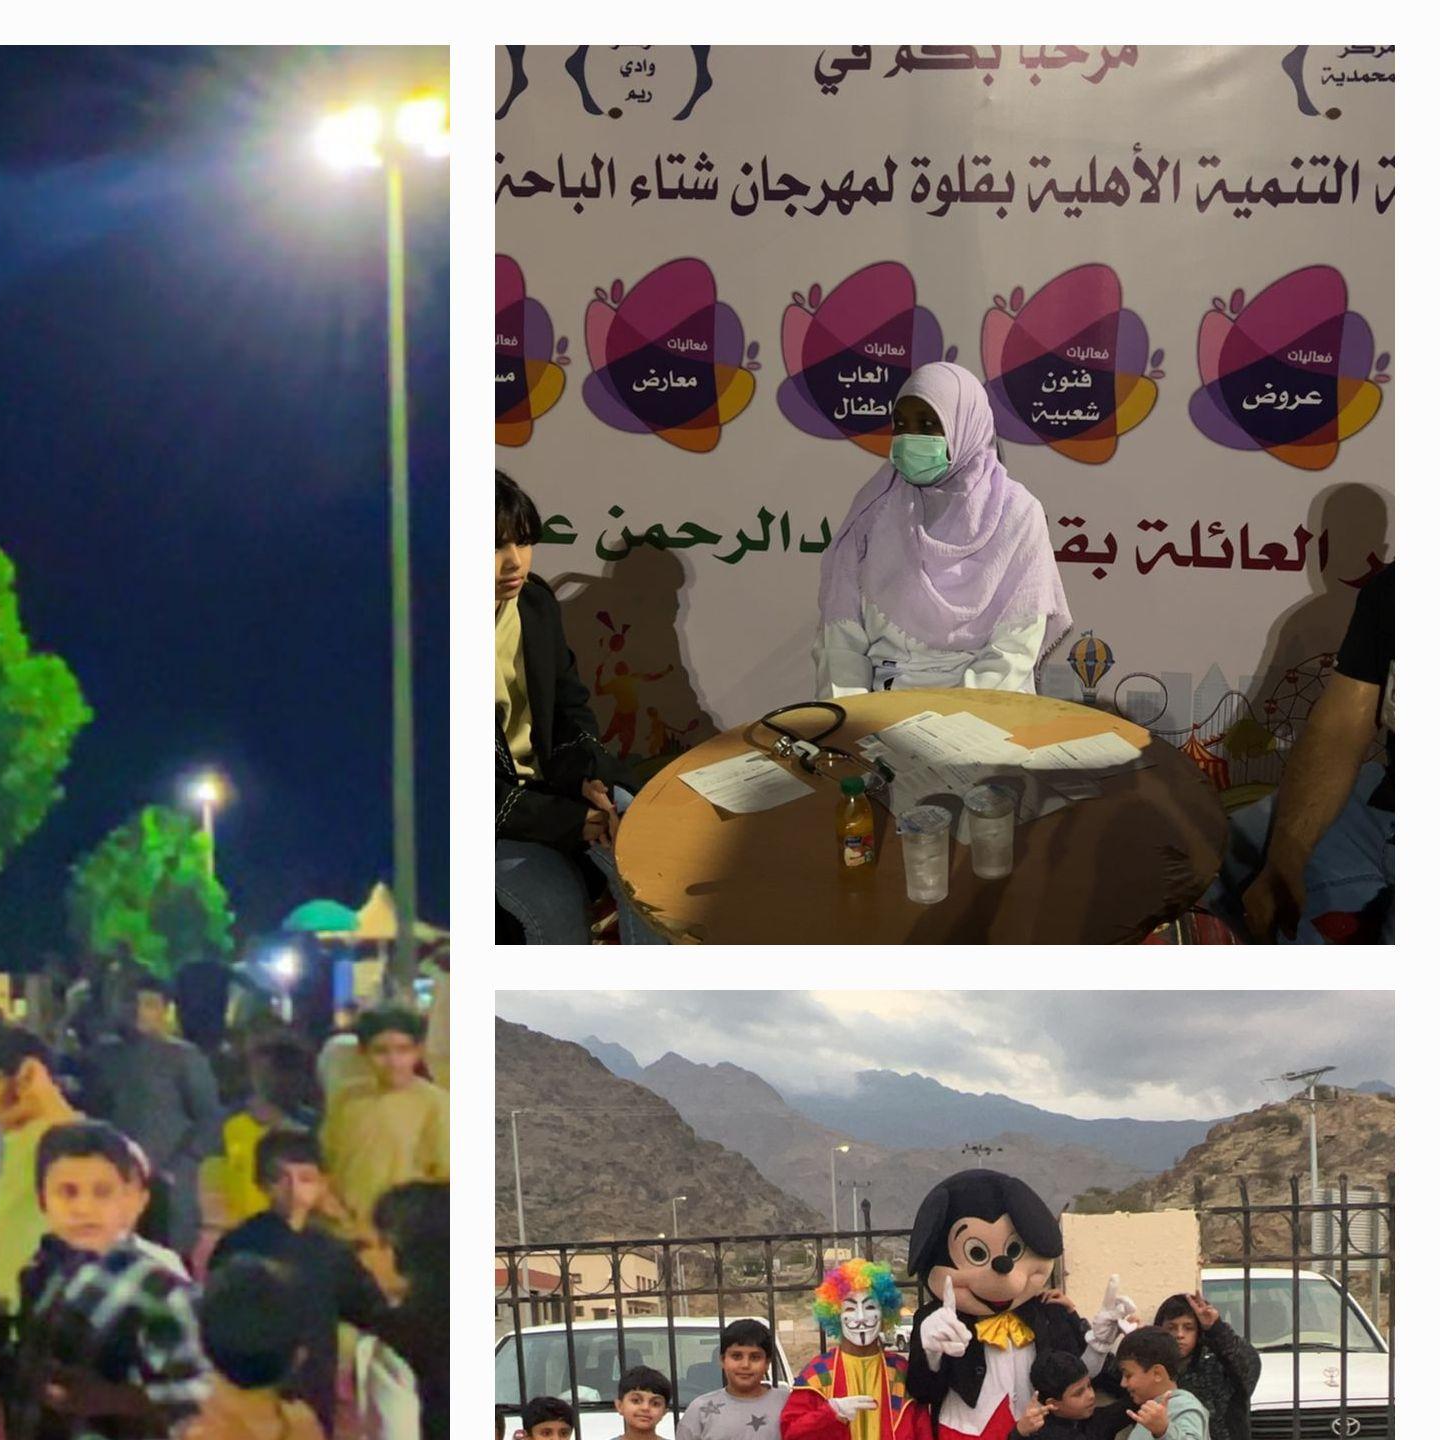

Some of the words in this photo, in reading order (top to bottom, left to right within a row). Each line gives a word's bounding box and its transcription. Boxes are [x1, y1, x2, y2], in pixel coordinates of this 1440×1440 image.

[619, 58, 656, 78] وادي
[624, 88, 654, 103] ريم
[629, 151, 719, 207] شتاء
[730, 153, 899, 218] لمهرجان
[910, 154, 1016, 220] بقلوة
[1027, 141, 1181, 220] الأهلية
[1195, 154, 1360, 220] التنمية
[666, 337, 709, 353] فعاليات
[863, 342, 906, 358] فعاليات
[1065, 346, 1110, 361] فعاليات
[1286, 349, 1333, 365] فعاليات
[632, 370, 698, 392] معارض
[837, 365, 890, 385] العاب
[1041, 368, 1093, 394] فنون
[1242, 383, 1323, 410] عروض
[1031, 401, 1100, 426] شعبية
[1135, 519, 1330, 576] العائلة
